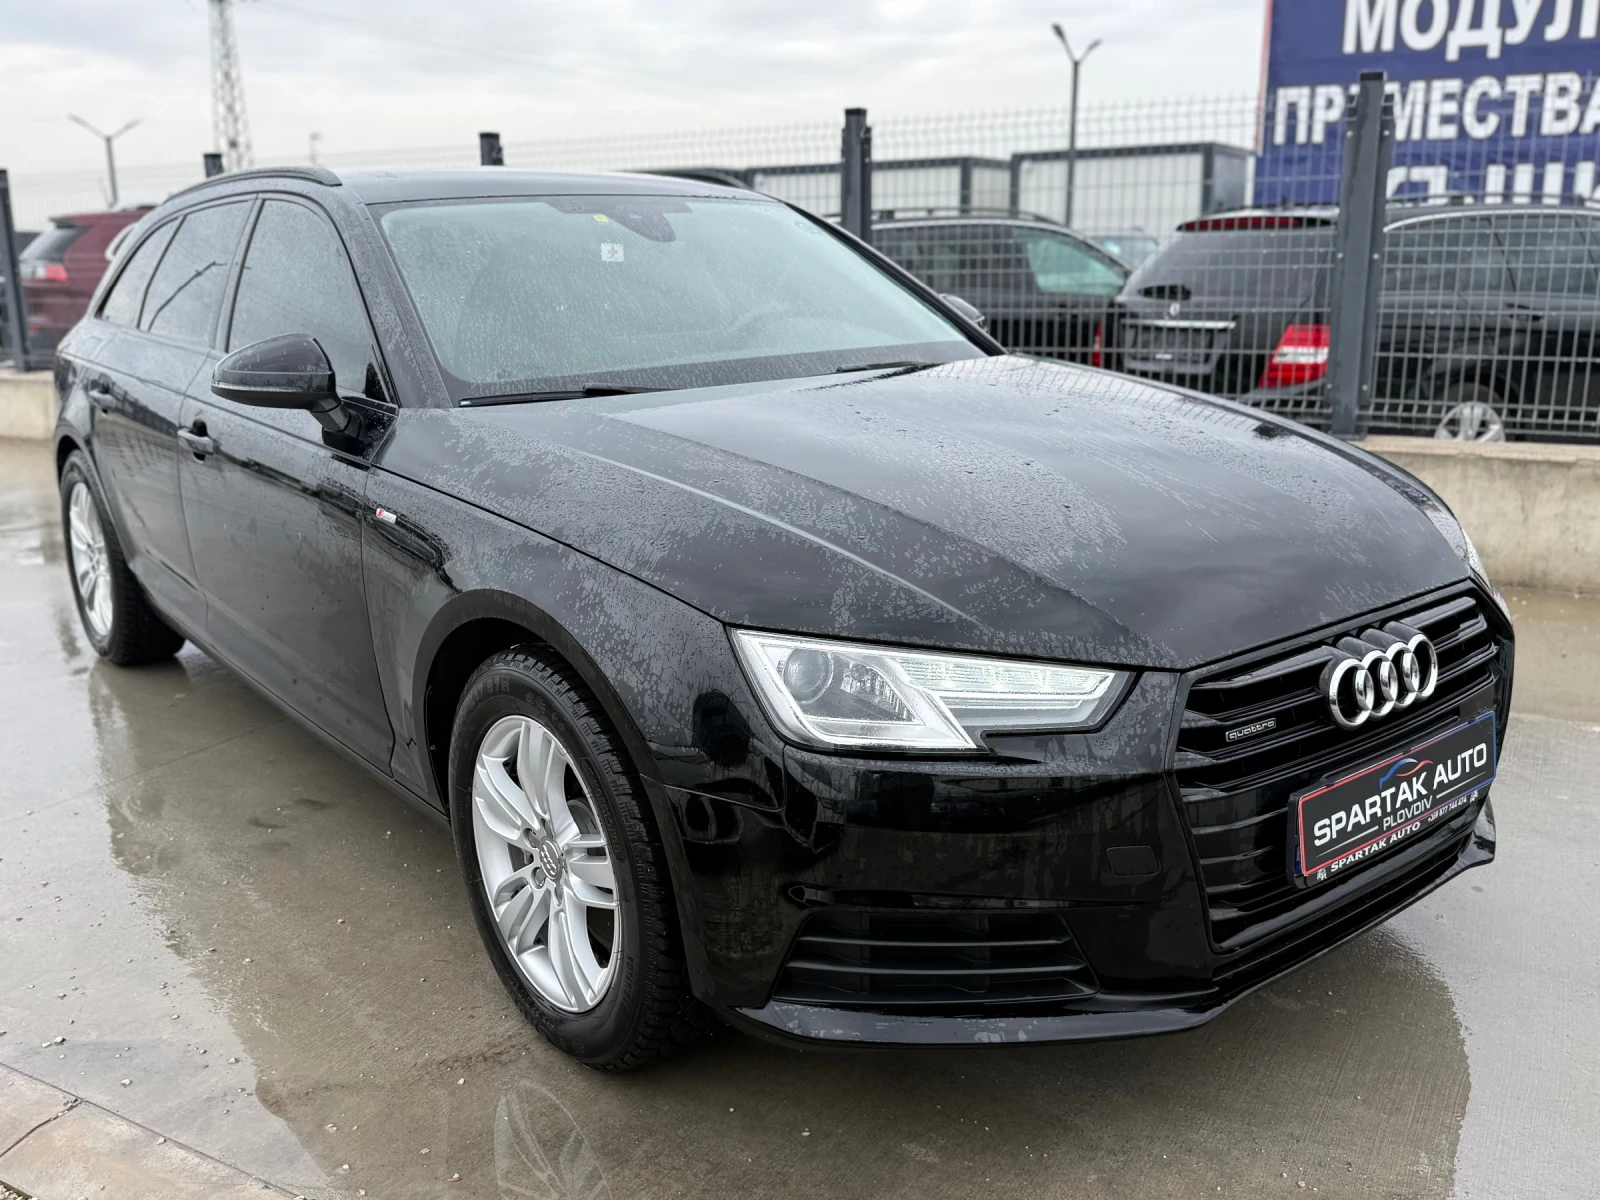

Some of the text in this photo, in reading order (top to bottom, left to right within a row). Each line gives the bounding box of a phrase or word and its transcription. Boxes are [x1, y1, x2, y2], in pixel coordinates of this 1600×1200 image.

[1272, 72, 1600, 145] ПРМЕСТВ
[1229, 720, 1275, 739] quattro
[1313, 742, 1487, 847] SPARTAK AUTO
[1383, 795, 1433, 831] PLOVDIV
[1330, 838, 1387, 872] SPARTAK
[1389, 821, 1421, 844] AUTO
